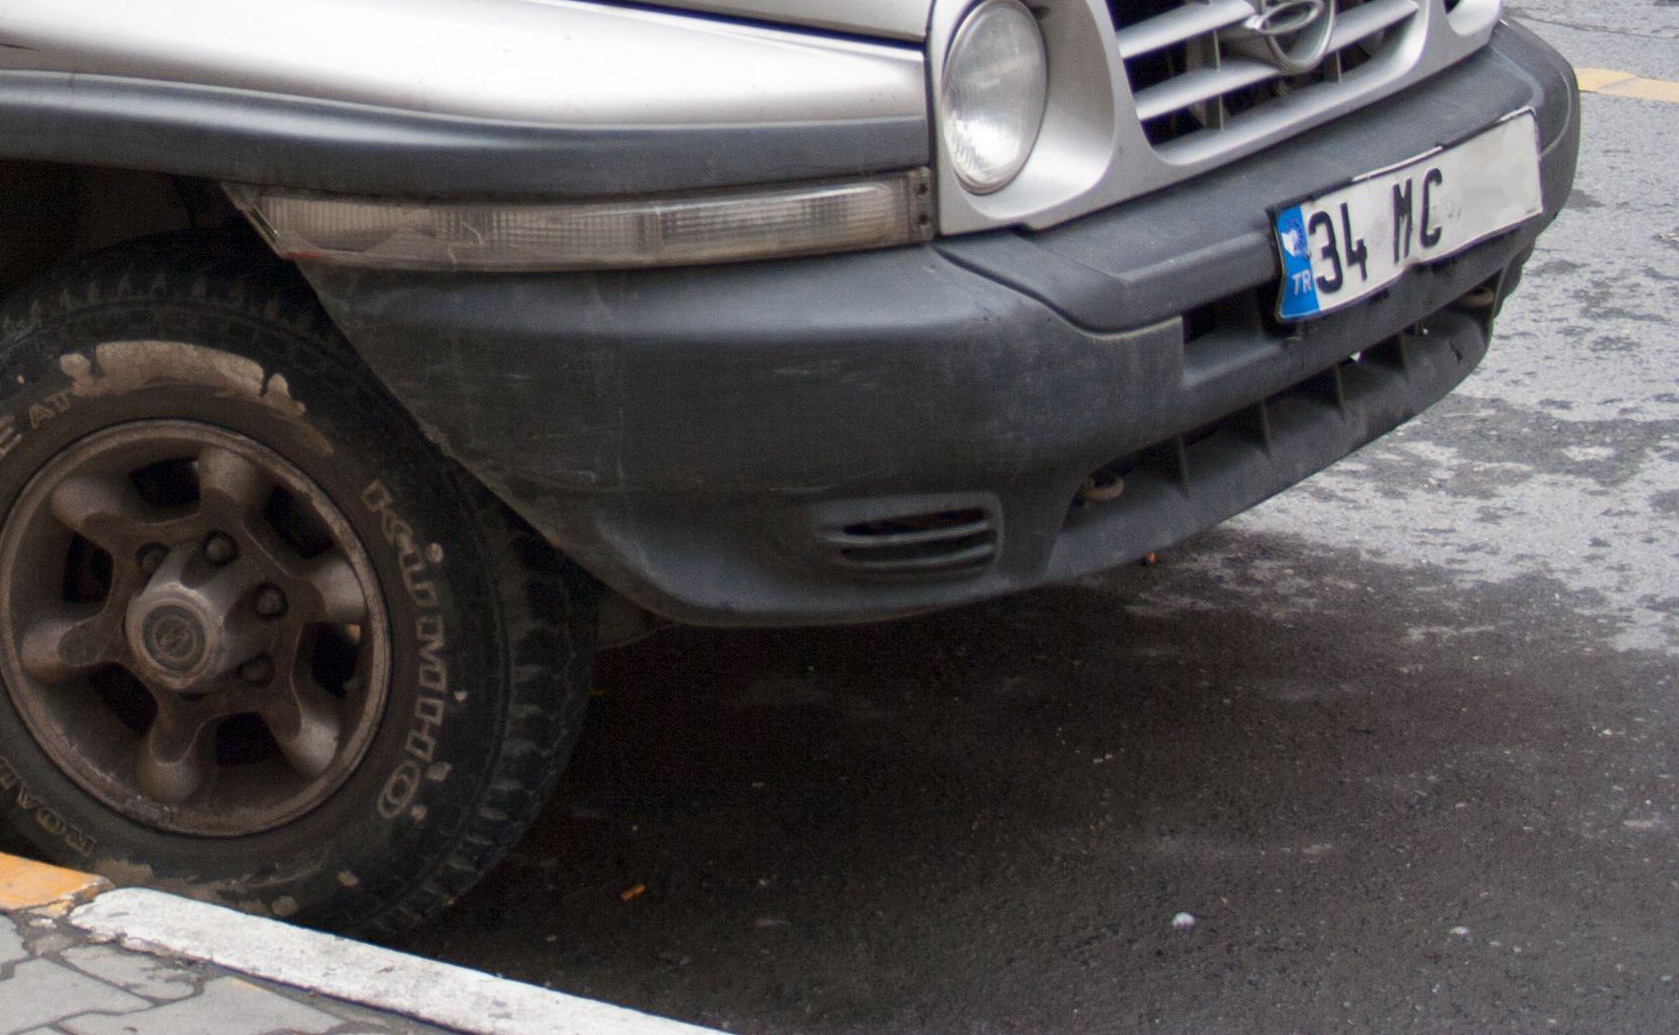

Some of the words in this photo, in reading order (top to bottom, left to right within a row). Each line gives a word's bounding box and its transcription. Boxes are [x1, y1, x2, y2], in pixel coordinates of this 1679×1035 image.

[1291, 269, 1312, 296] TR
[1308, 203, 1368, 294] 34
[1392, 167, 1442, 264] MC
[362, 479, 447, 821] KUMHO
